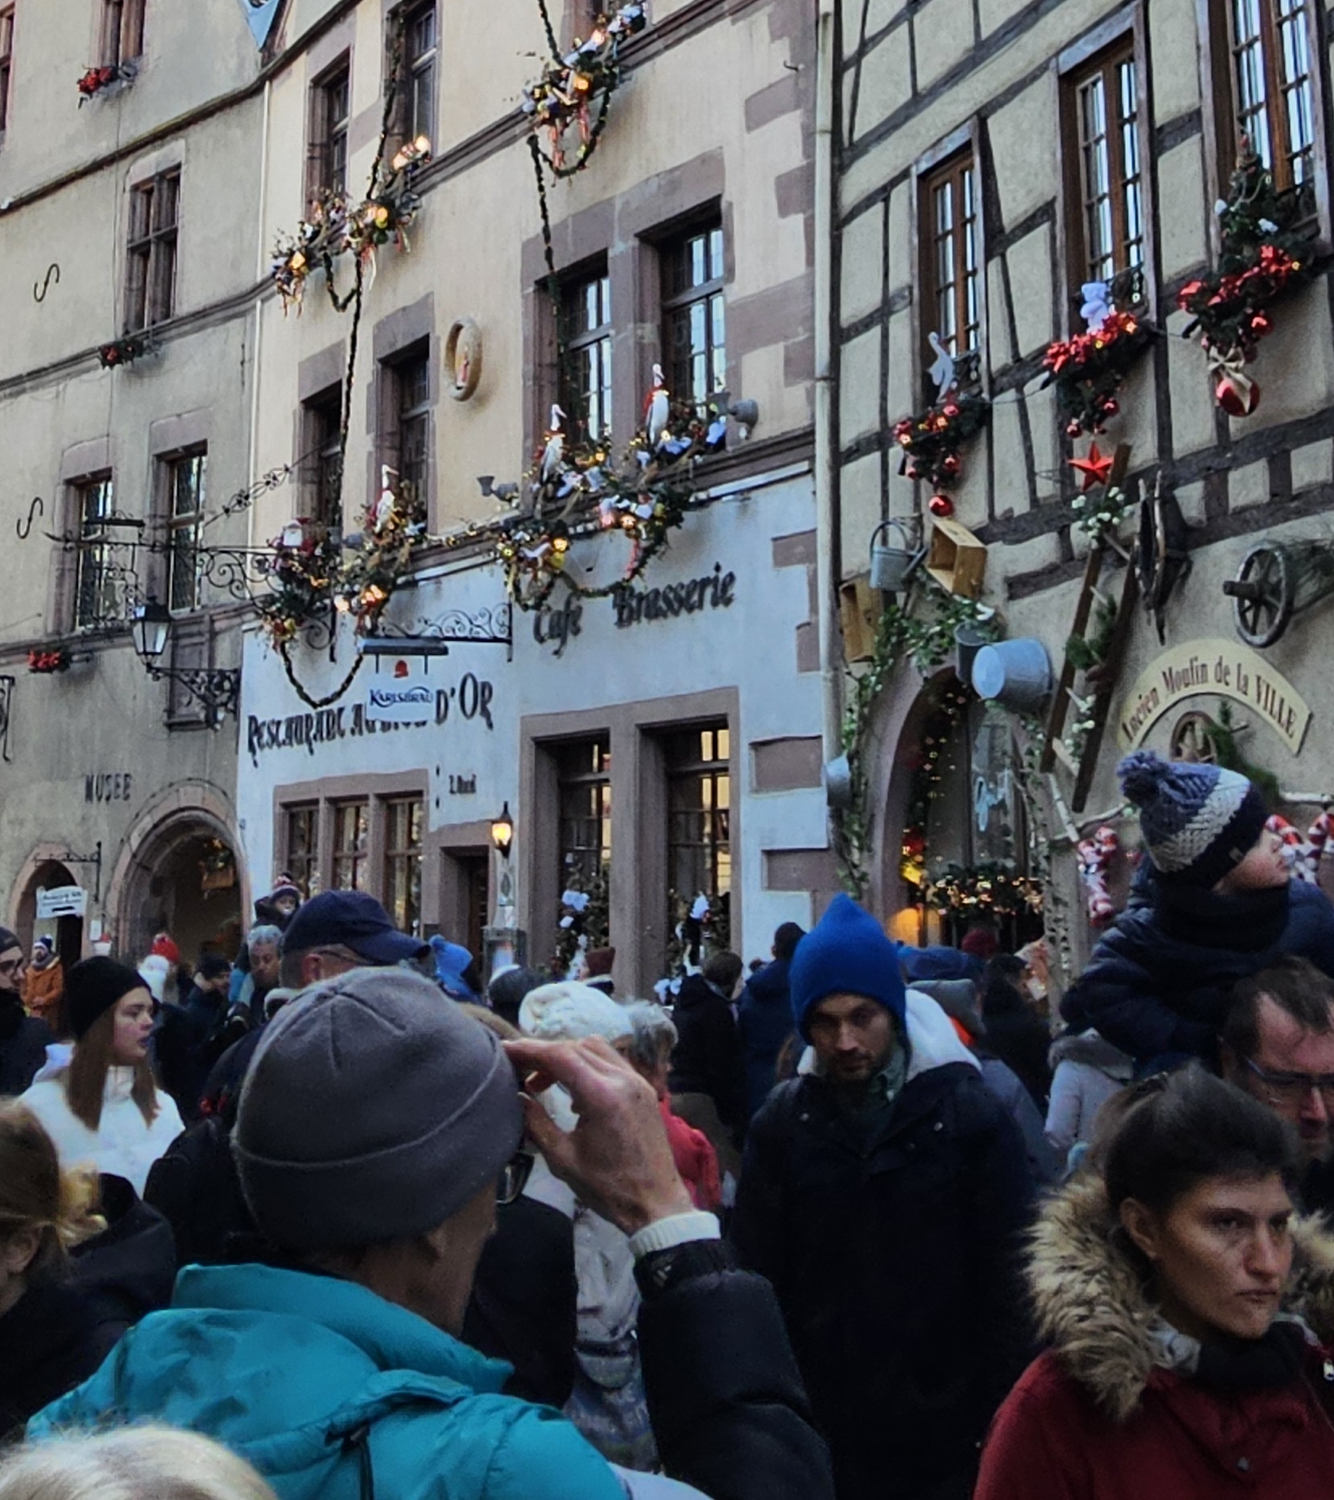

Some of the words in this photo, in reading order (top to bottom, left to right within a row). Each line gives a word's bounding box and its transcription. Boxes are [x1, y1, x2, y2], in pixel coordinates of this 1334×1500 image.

[612, 561, 737, 629] Brasserie
[1162, 656, 1209, 694] Moulin
[1214, 655, 1231, 687] de
[1236, 663, 1249, 696] la
[1256, 674, 1297, 739] VILLE
